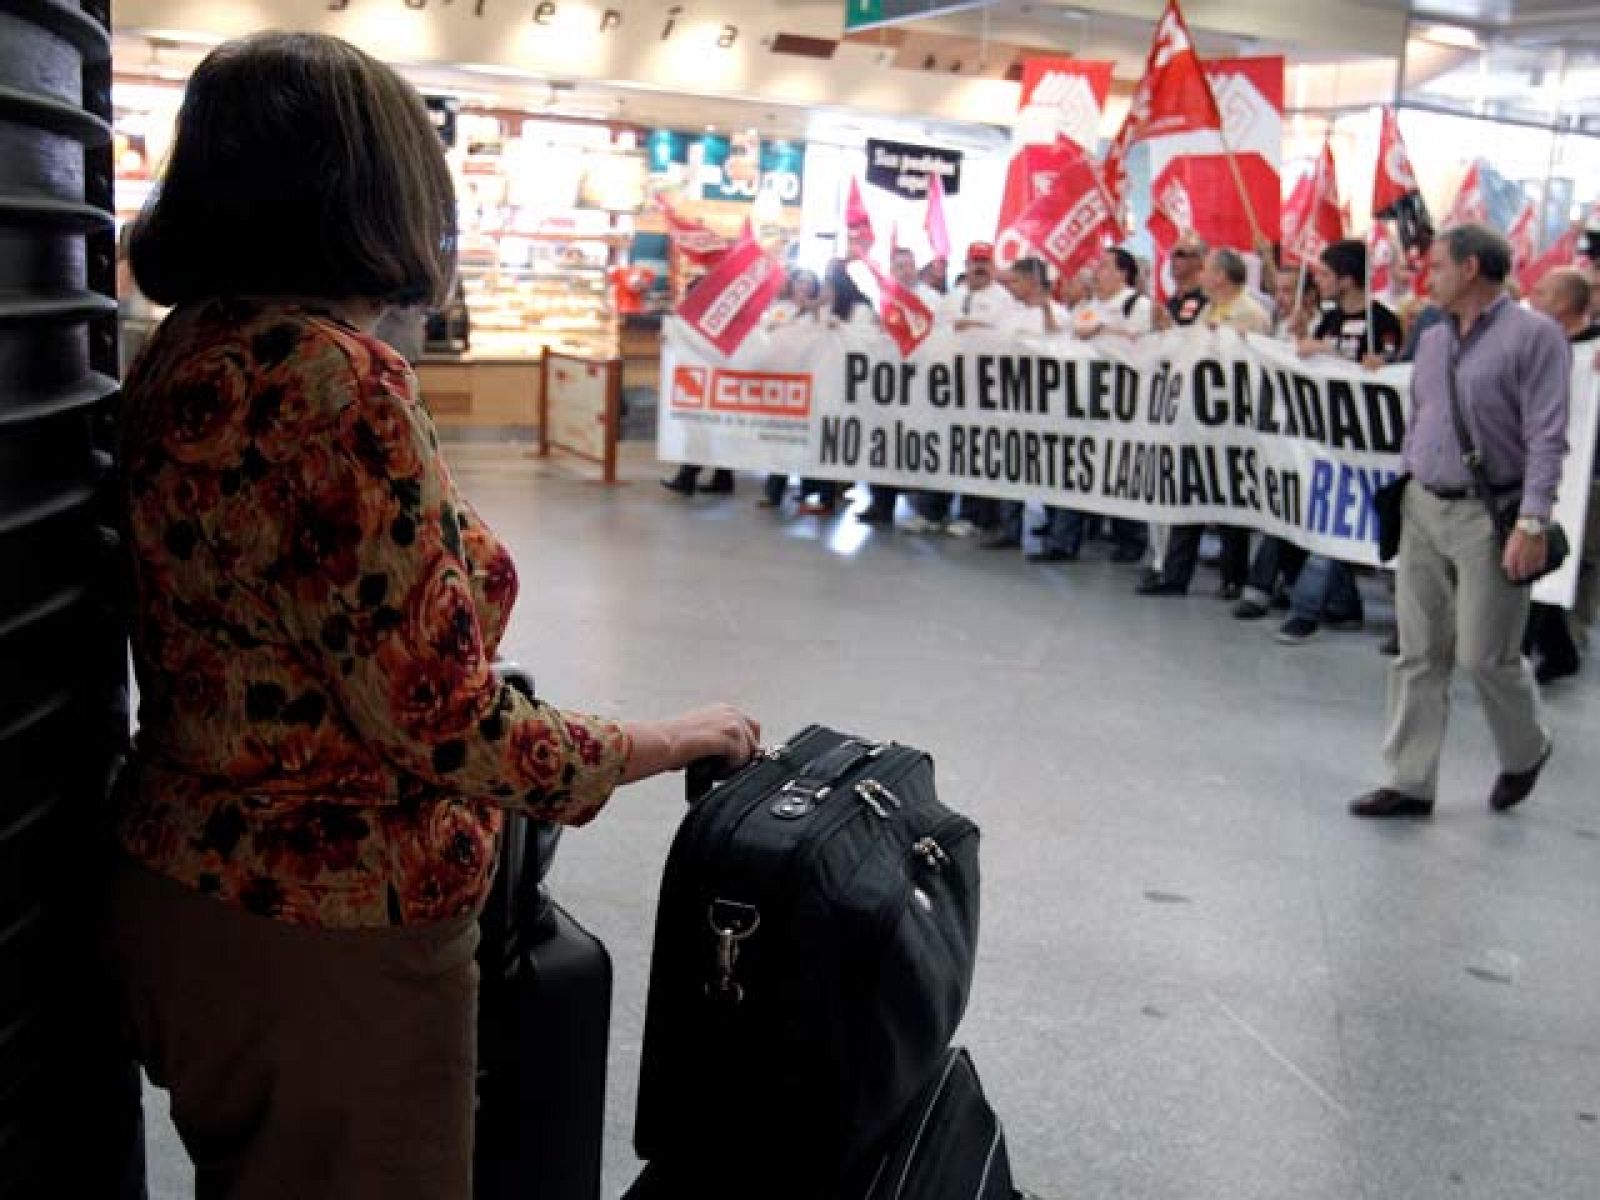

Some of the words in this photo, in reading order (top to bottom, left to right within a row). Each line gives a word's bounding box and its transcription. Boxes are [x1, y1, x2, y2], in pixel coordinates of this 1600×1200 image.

[713, 373, 810, 411] CCOO
[846, 352, 917, 405] Por
[928, 355, 965, 408] el
[977, 355, 1140, 422] EMPLEO
[1147, 359, 1183, 425] de
[1192, 359, 1405, 453] CALIDAD
[820, 416, 861, 467] NO
[869, 427, 887, 468] a
[895, 420, 940, 474] los
[949, 424, 1096, 493] RECORTES
[1102, 437, 1261, 511] LABORALES
[1265, 467, 1300, 525] en
[1306, 459, 1397, 544] REX
